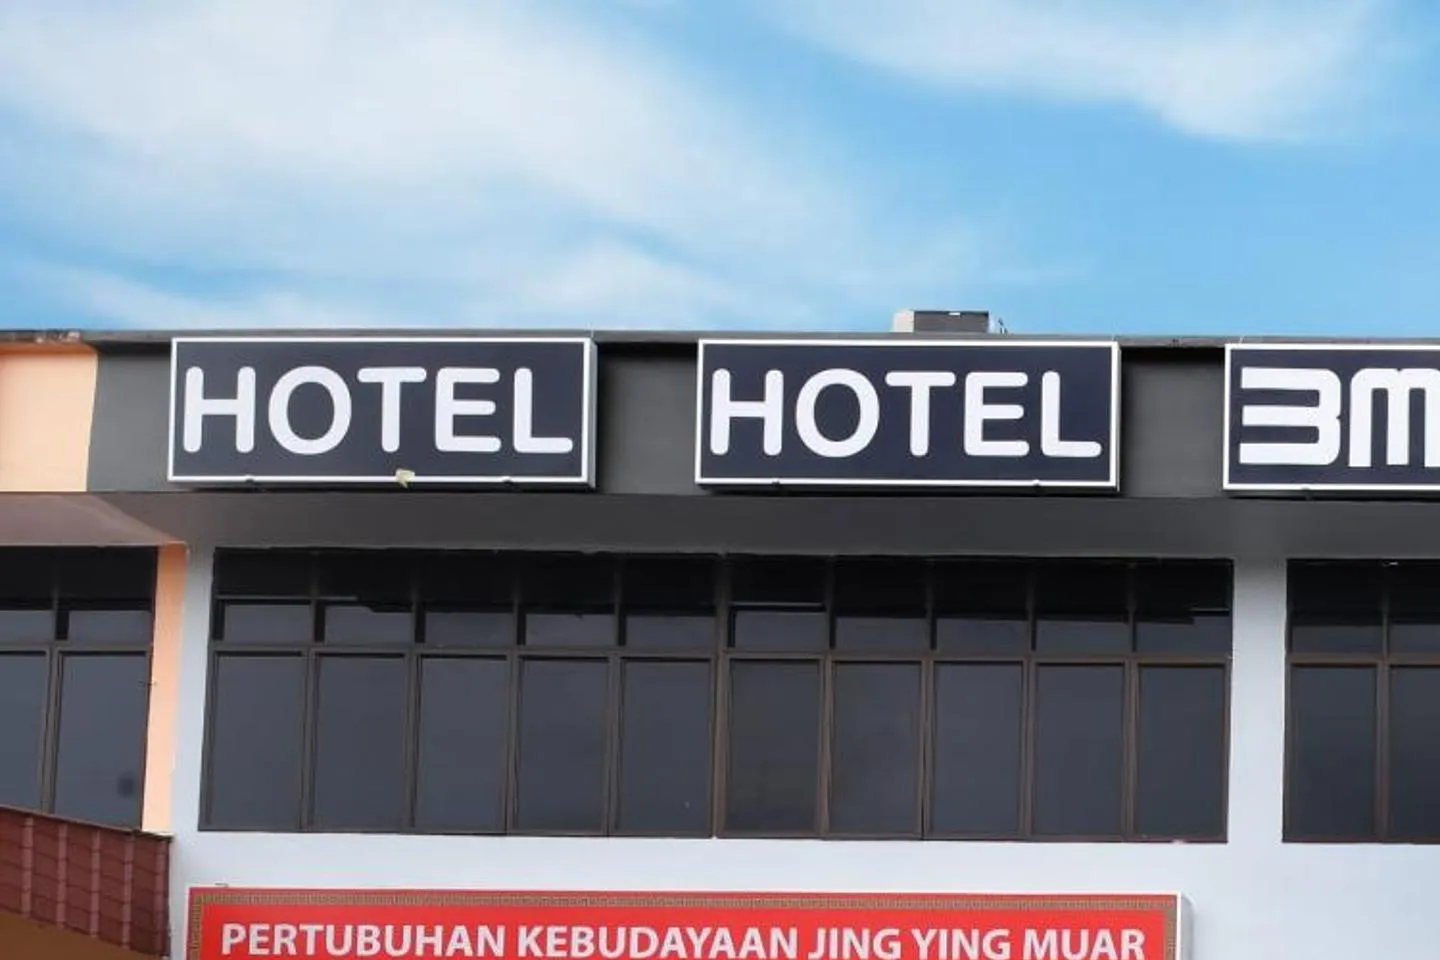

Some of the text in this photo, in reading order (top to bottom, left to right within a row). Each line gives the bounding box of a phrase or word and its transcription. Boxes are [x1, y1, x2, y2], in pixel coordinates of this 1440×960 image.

[183, 365, 574, 455] HOTEL
[710, 368, 1102, 458] HOTEL
[221, 922, 506, 958] PERTUBUHAN
[517, 925, 799, 960] KEBUDAYAAN
